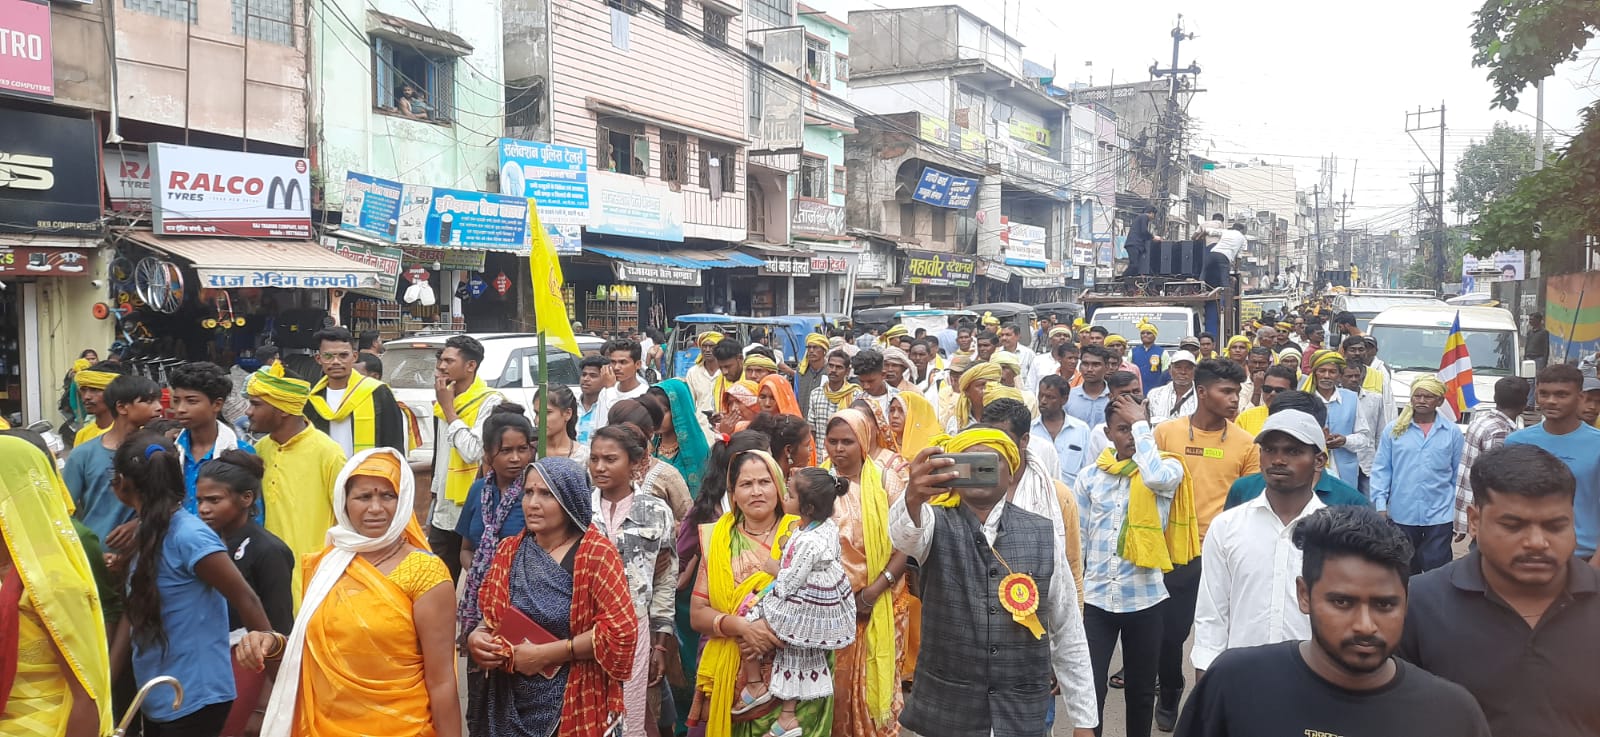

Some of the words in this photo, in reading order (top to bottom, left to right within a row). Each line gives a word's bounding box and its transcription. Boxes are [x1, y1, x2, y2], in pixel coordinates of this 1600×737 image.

[120, 180, 150, 189] TYRE
[169, 170, 264, 196] RALCO
[168, 192, 204, 202] TYRES
[909, 254, 945, 277] महावीर
[208, 274, 245, 287] राज
[303, 273, 358, 288] कम्पनी
